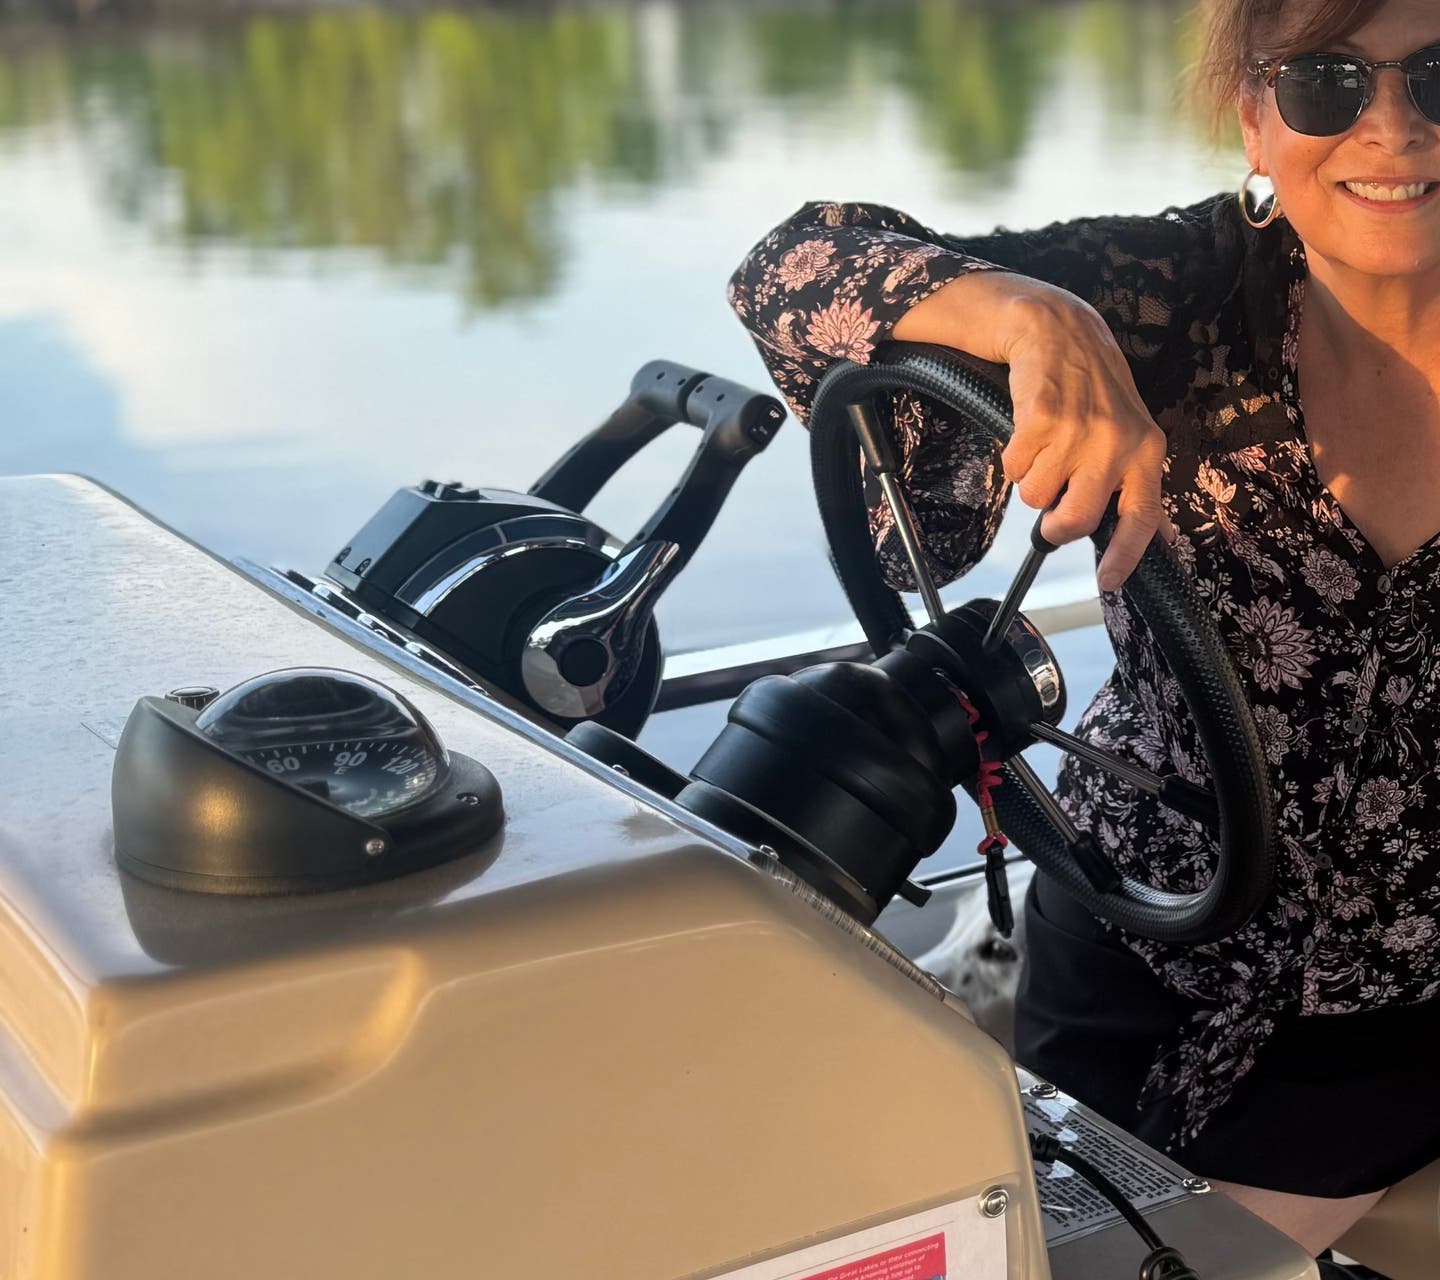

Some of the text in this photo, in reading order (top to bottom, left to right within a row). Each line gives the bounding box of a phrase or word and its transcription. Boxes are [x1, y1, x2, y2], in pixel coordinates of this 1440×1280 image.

[265, 756, 300, 773] 60
[333, 751, 368, 767] 90
[381, 756, 420, 775] 120
[333, 766, 349, 775] E
